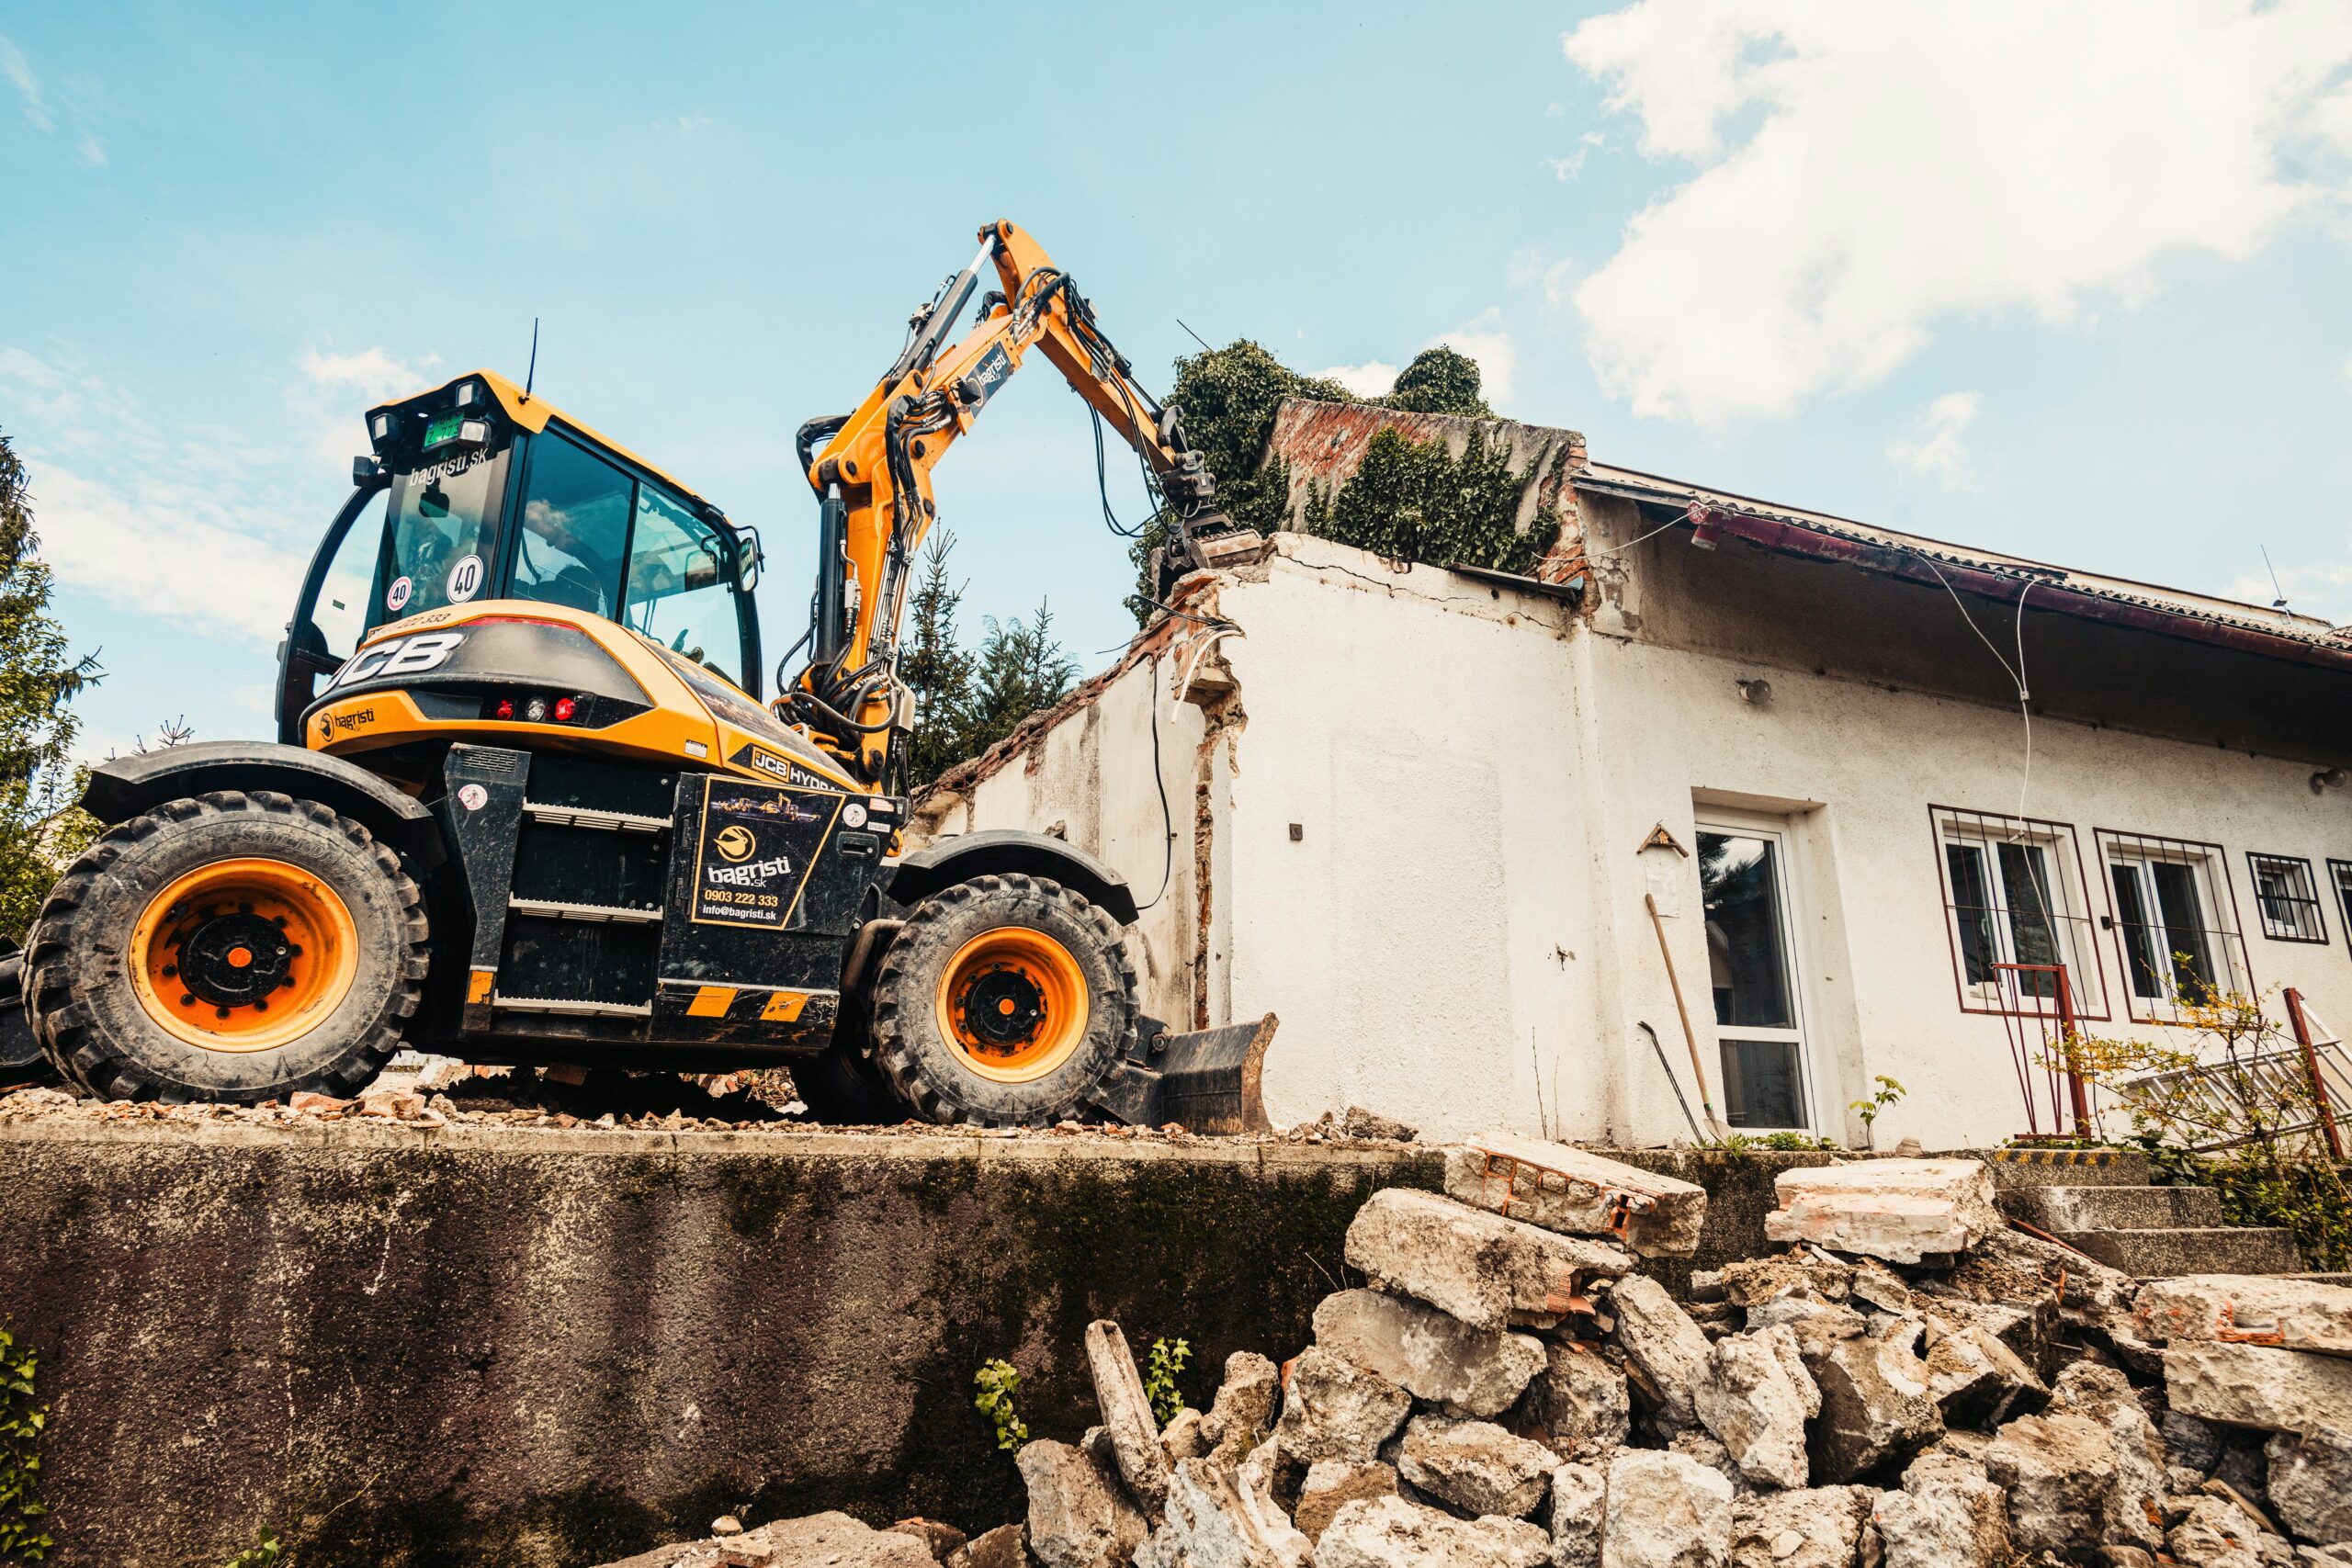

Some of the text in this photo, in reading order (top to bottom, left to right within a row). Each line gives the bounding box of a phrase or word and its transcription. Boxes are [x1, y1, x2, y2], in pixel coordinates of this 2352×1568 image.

[978, 352, 1006, 386] bagristi
[454, 564, 476, 594] 40
[392, 584, 407, 602] 40
[334, 708, 375, 730] bagristi
[755, 754, 787, 777] JCB
[707, 856, 791, 886] bagristi
[704, 889, 779, 907] 0903 222 333
[702, 905, 777, 919] info@bagristi.sk
